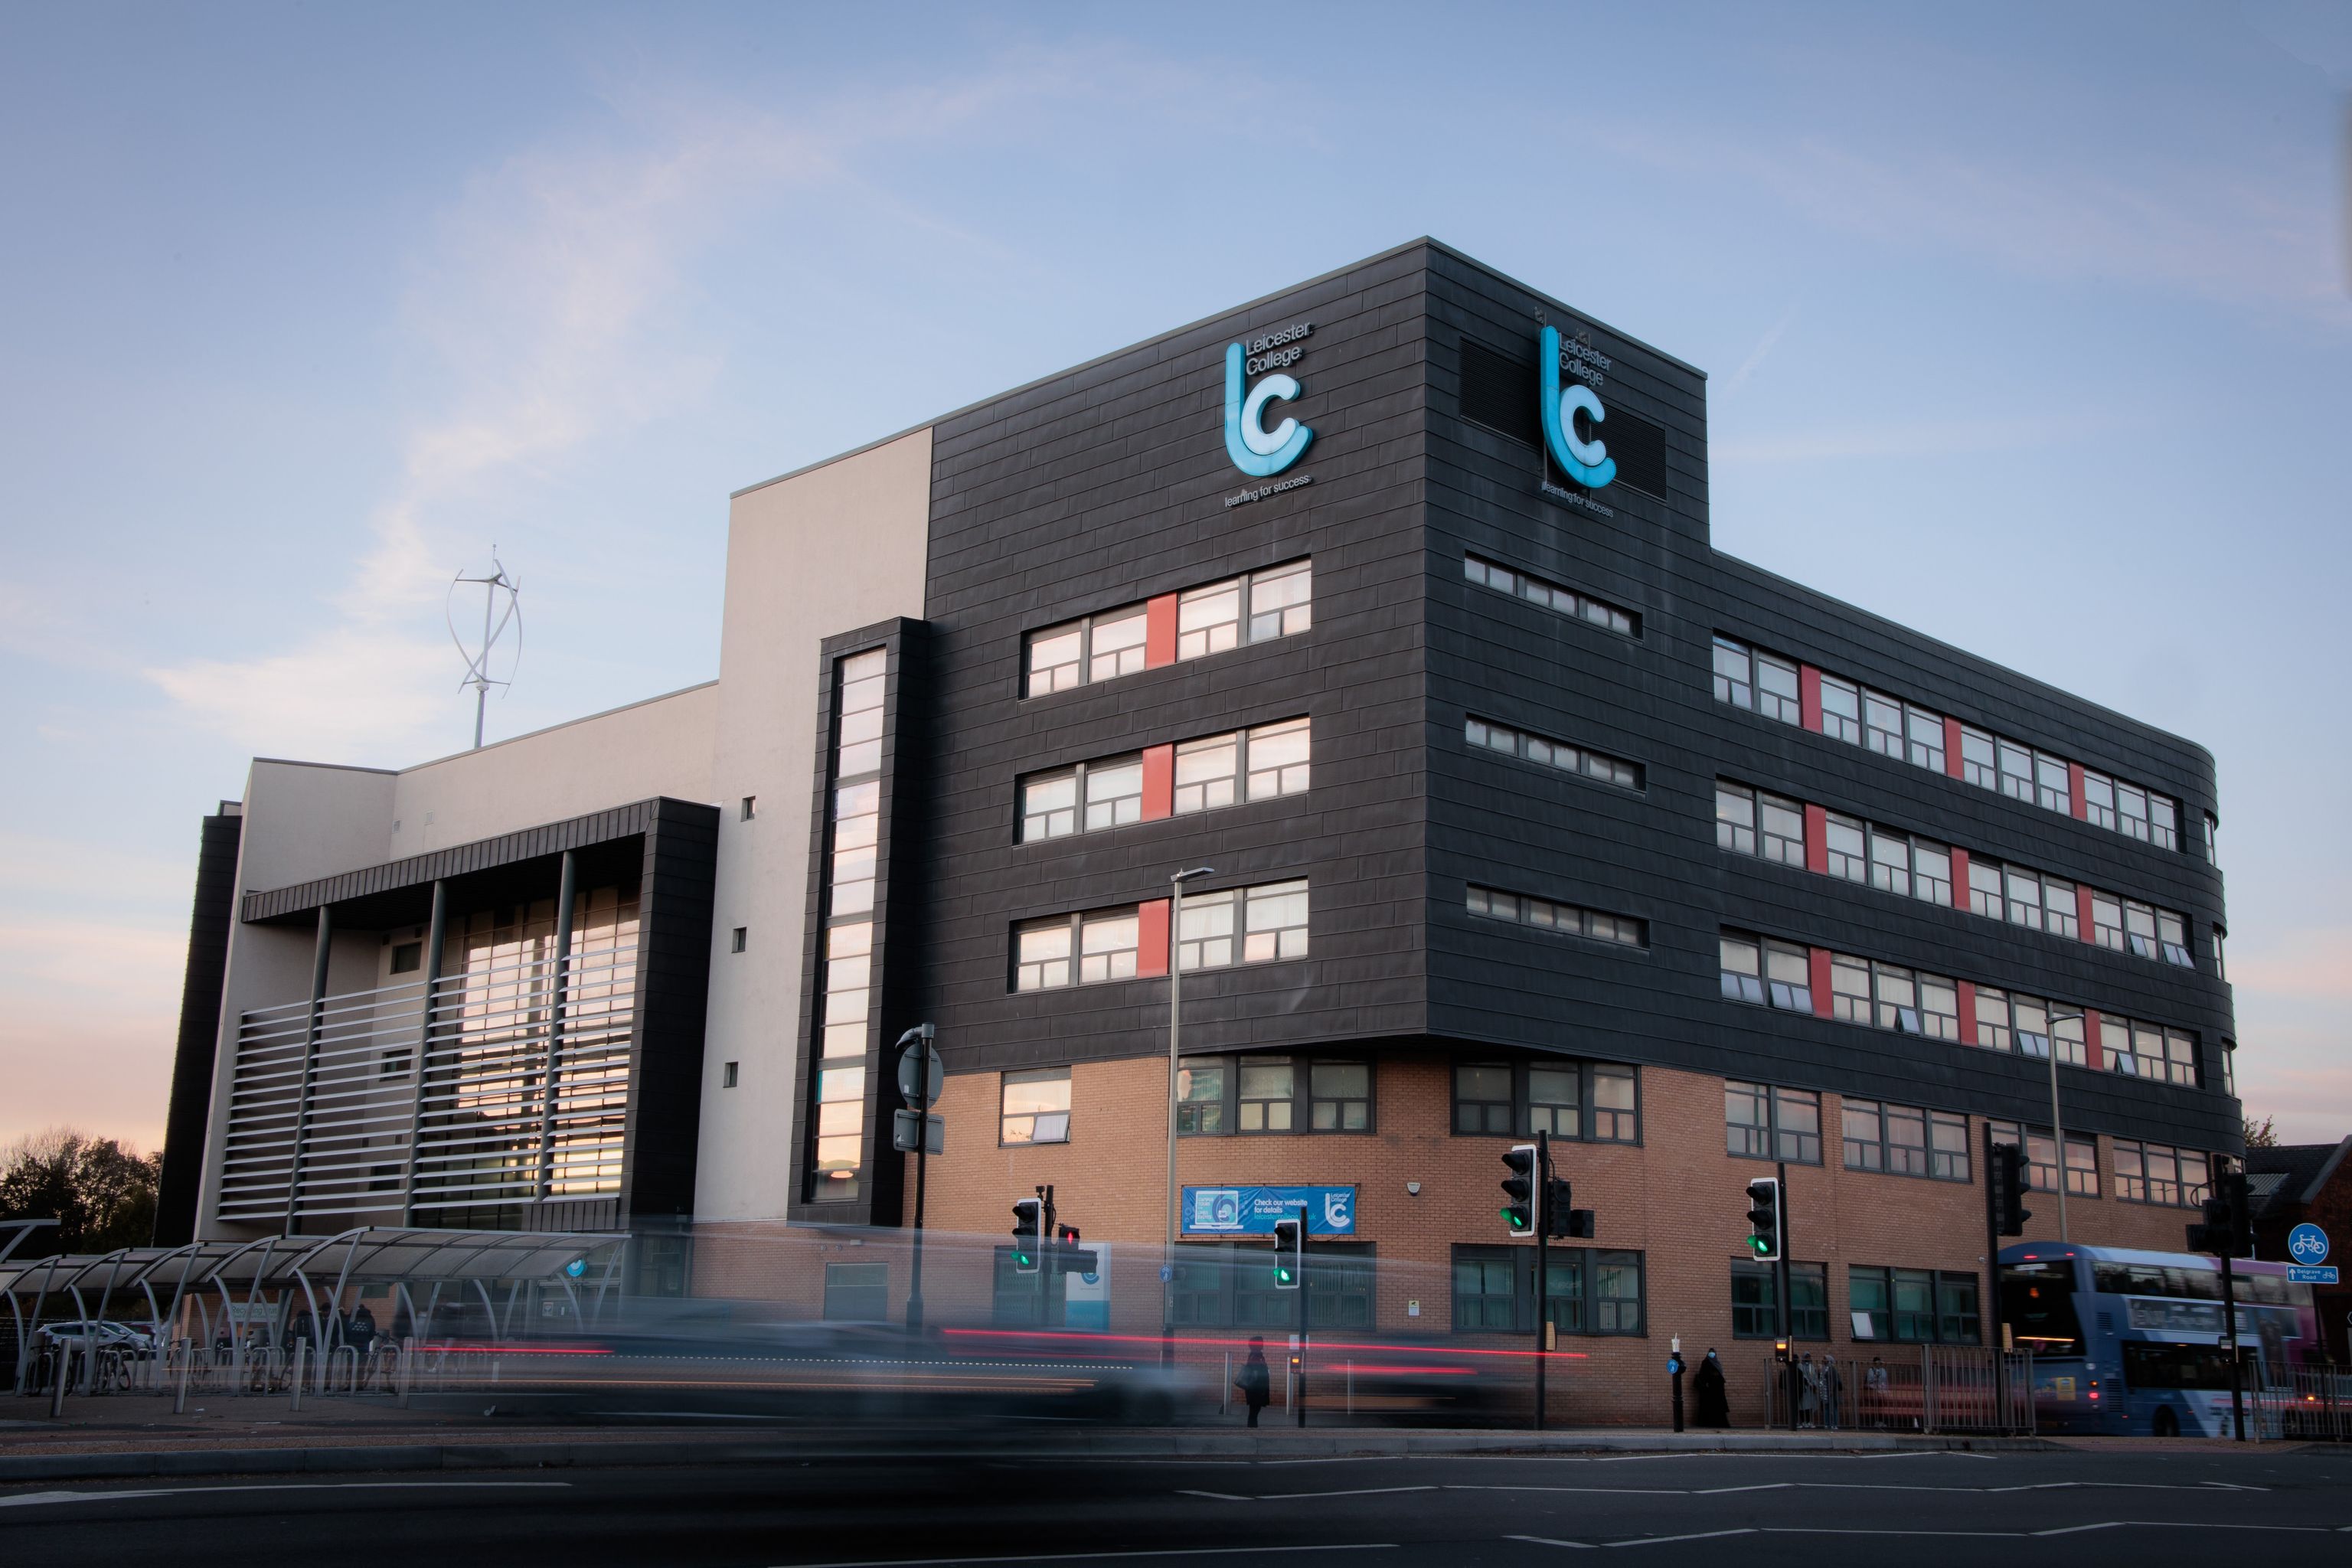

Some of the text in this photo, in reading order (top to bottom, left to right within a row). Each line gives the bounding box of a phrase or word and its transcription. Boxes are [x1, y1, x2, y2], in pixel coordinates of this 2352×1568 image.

[1246, 322, 1311, 356] Leicester
[1559, 332, 1612, 371] Leicester
[1246, 346, 1302, 376] College
[1559, 351, 1604, 387] College
[1225, 475, 1311, 508] learning for success
[1541, 481, 1614, 518] learning for success
